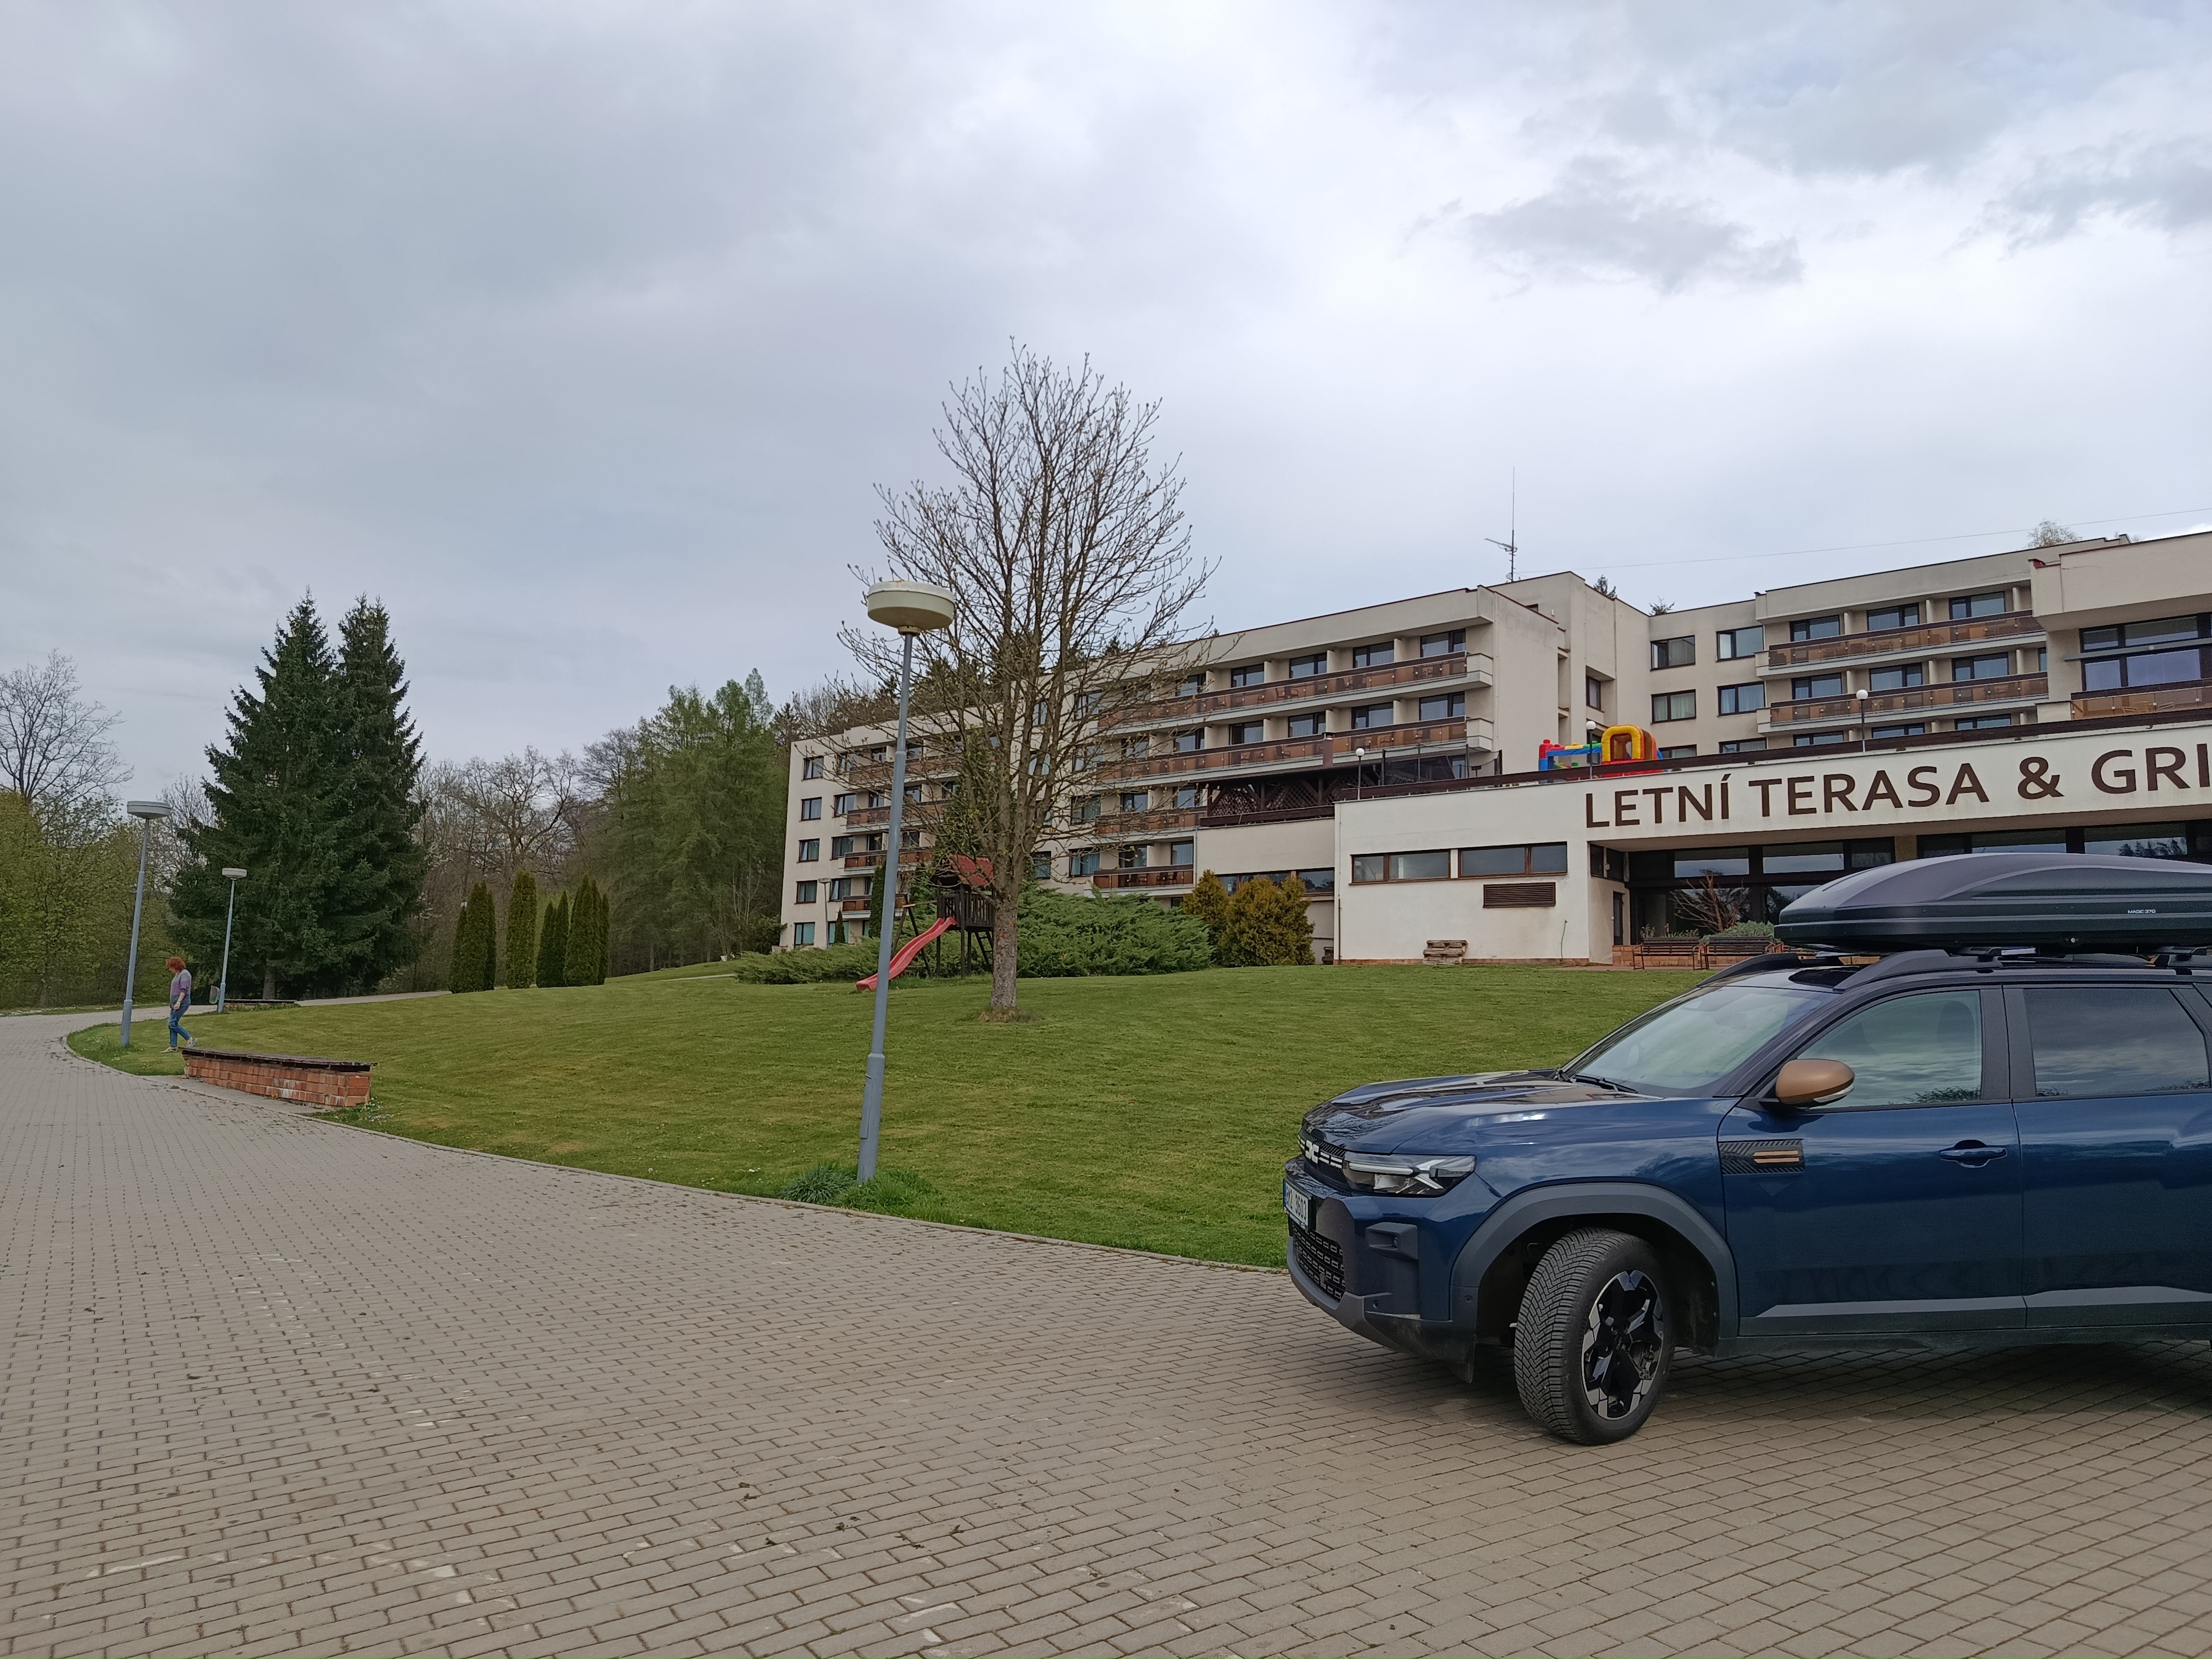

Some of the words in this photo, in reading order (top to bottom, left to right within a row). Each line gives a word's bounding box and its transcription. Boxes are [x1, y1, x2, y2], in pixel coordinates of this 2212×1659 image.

[1586, 773, 1731, 828] LETNÍ
[1748, 763, 1990, 817] TERASA
[2018, 757, 2064, 800] &
[2091, 743, 2210, 794] GRI
